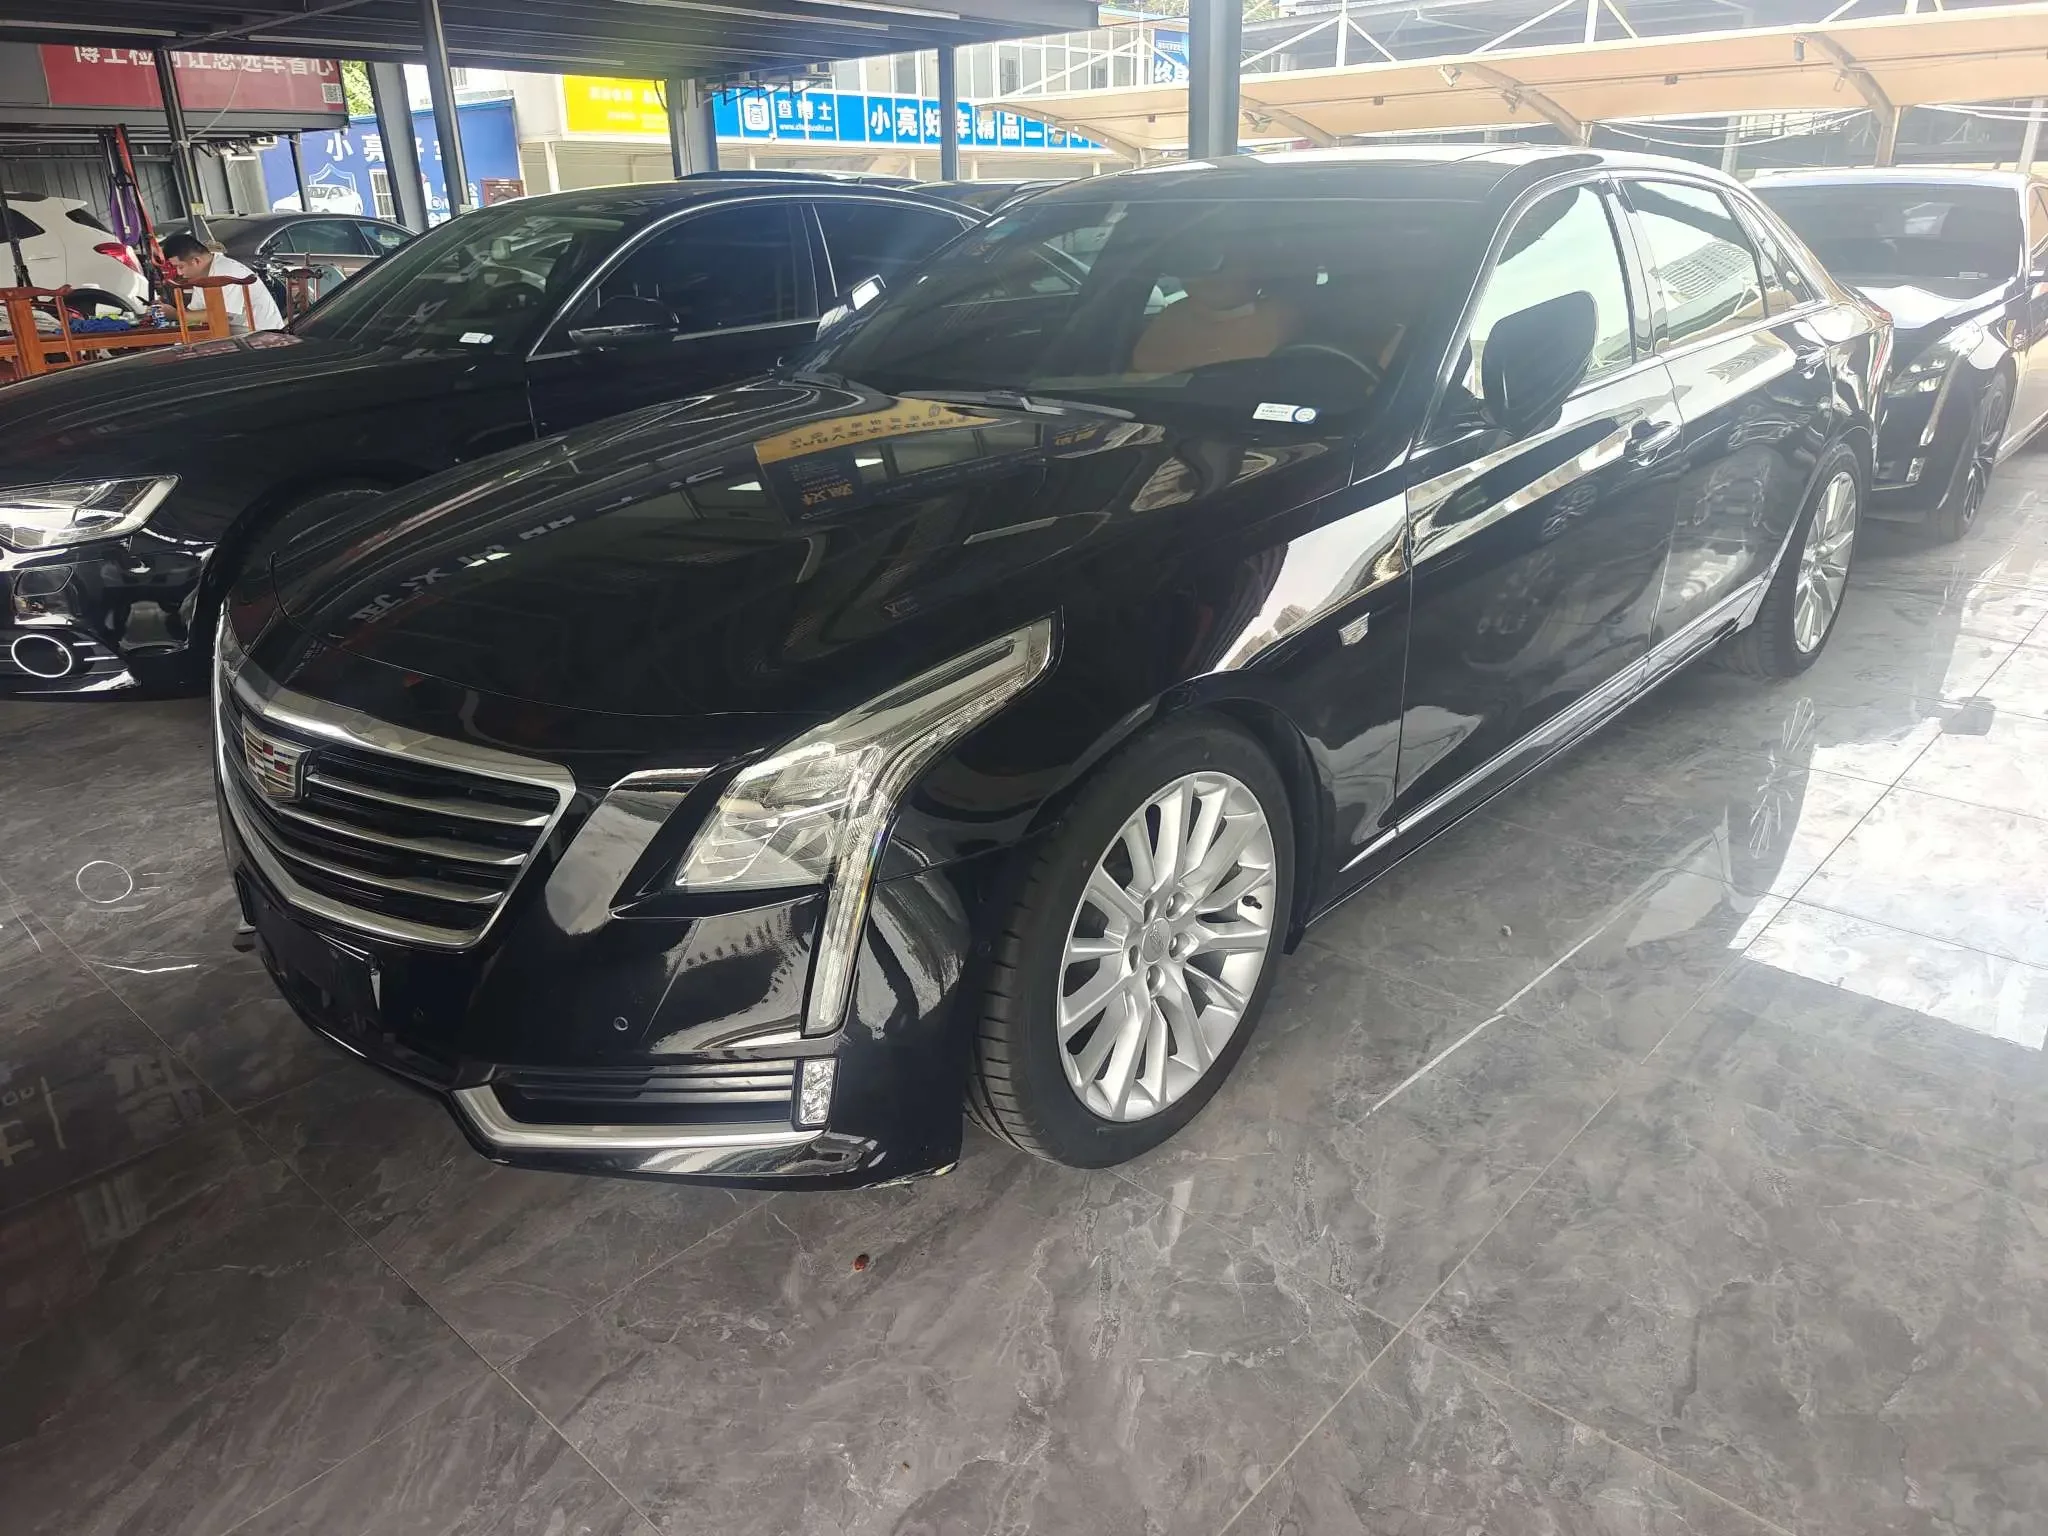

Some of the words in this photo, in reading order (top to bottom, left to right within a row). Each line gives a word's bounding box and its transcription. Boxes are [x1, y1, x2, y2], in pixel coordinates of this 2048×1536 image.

[871, 104, 1088, 142] 小亮好车精品二
